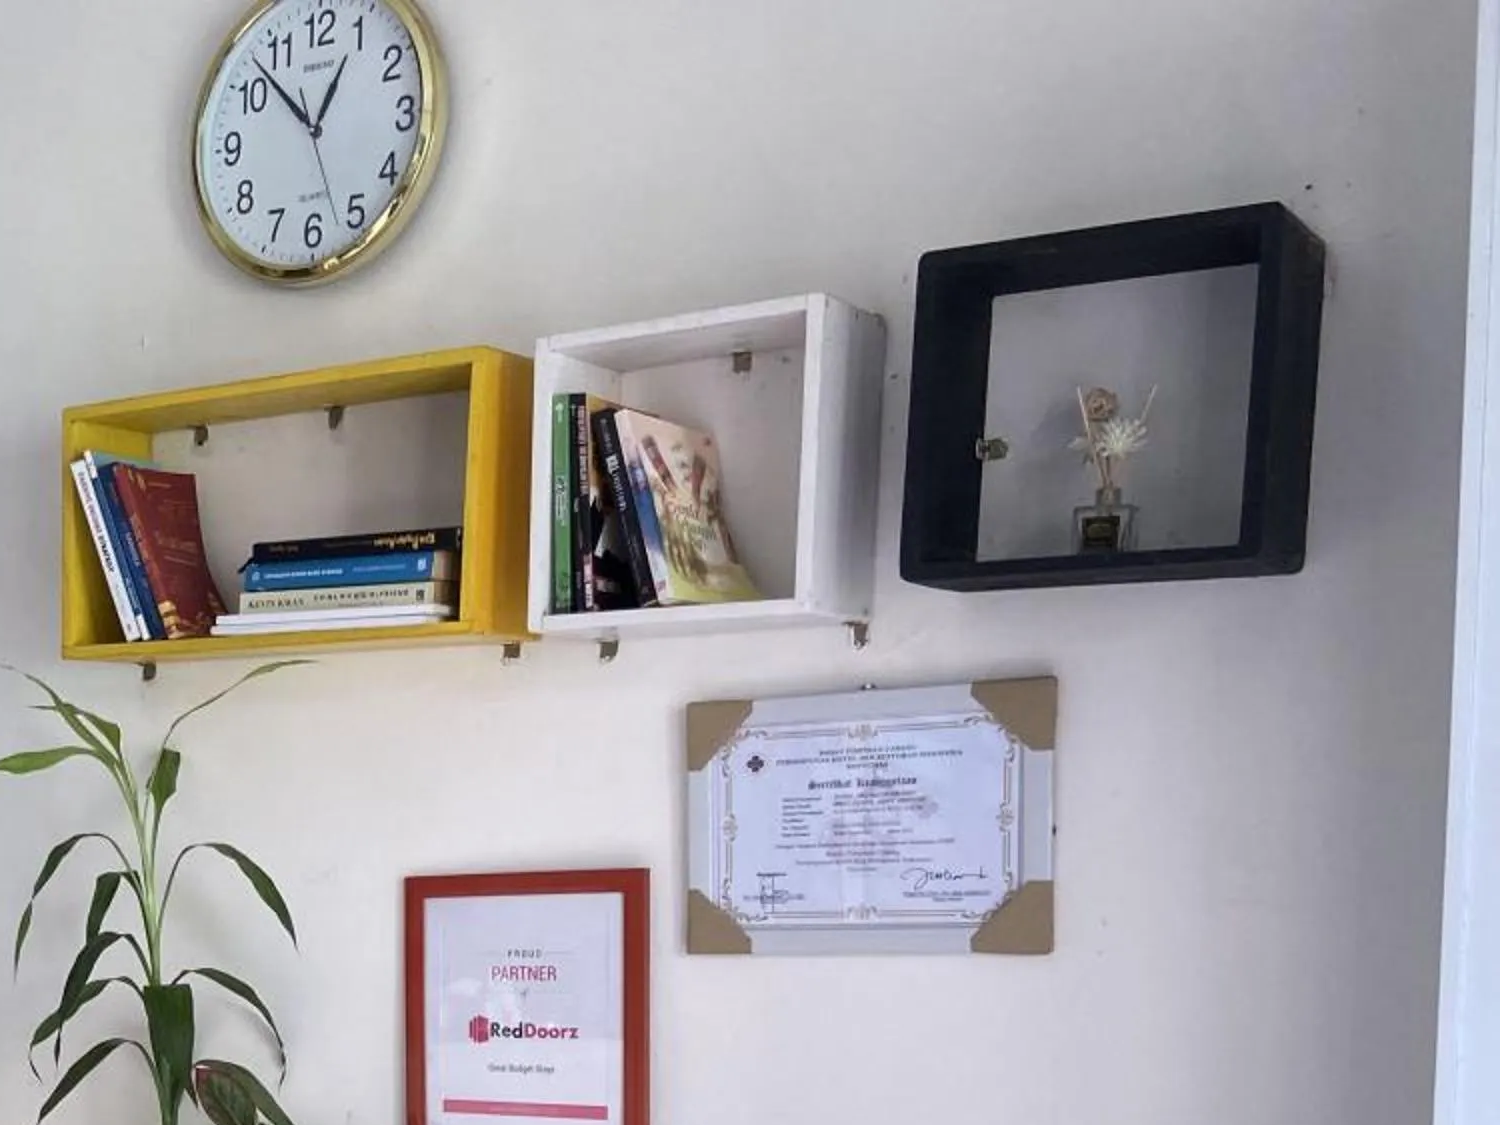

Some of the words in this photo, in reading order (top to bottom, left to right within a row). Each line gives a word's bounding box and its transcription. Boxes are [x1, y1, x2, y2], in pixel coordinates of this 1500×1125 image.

[303, 9, 336, 48] 12
[353, 15, 363, 51] 1
[267, 32, 293, 70] 11
[382, 45, 402, 82] 2
[238, 77, 267, 115] 10
[395, 95, 415, 132] 3
[223, 131, 242, 166] 9
[379, 150, 398, 186] 4
[236, 179, 253, 215] 8
[347, 193, 365, 229] 5
[267, 208, 285, 243] 7
[303, 213, 323, 248] 6
[491, 965, 557, 982] PARTNER
[490, 1021, 579, 1040] RedDoorz
